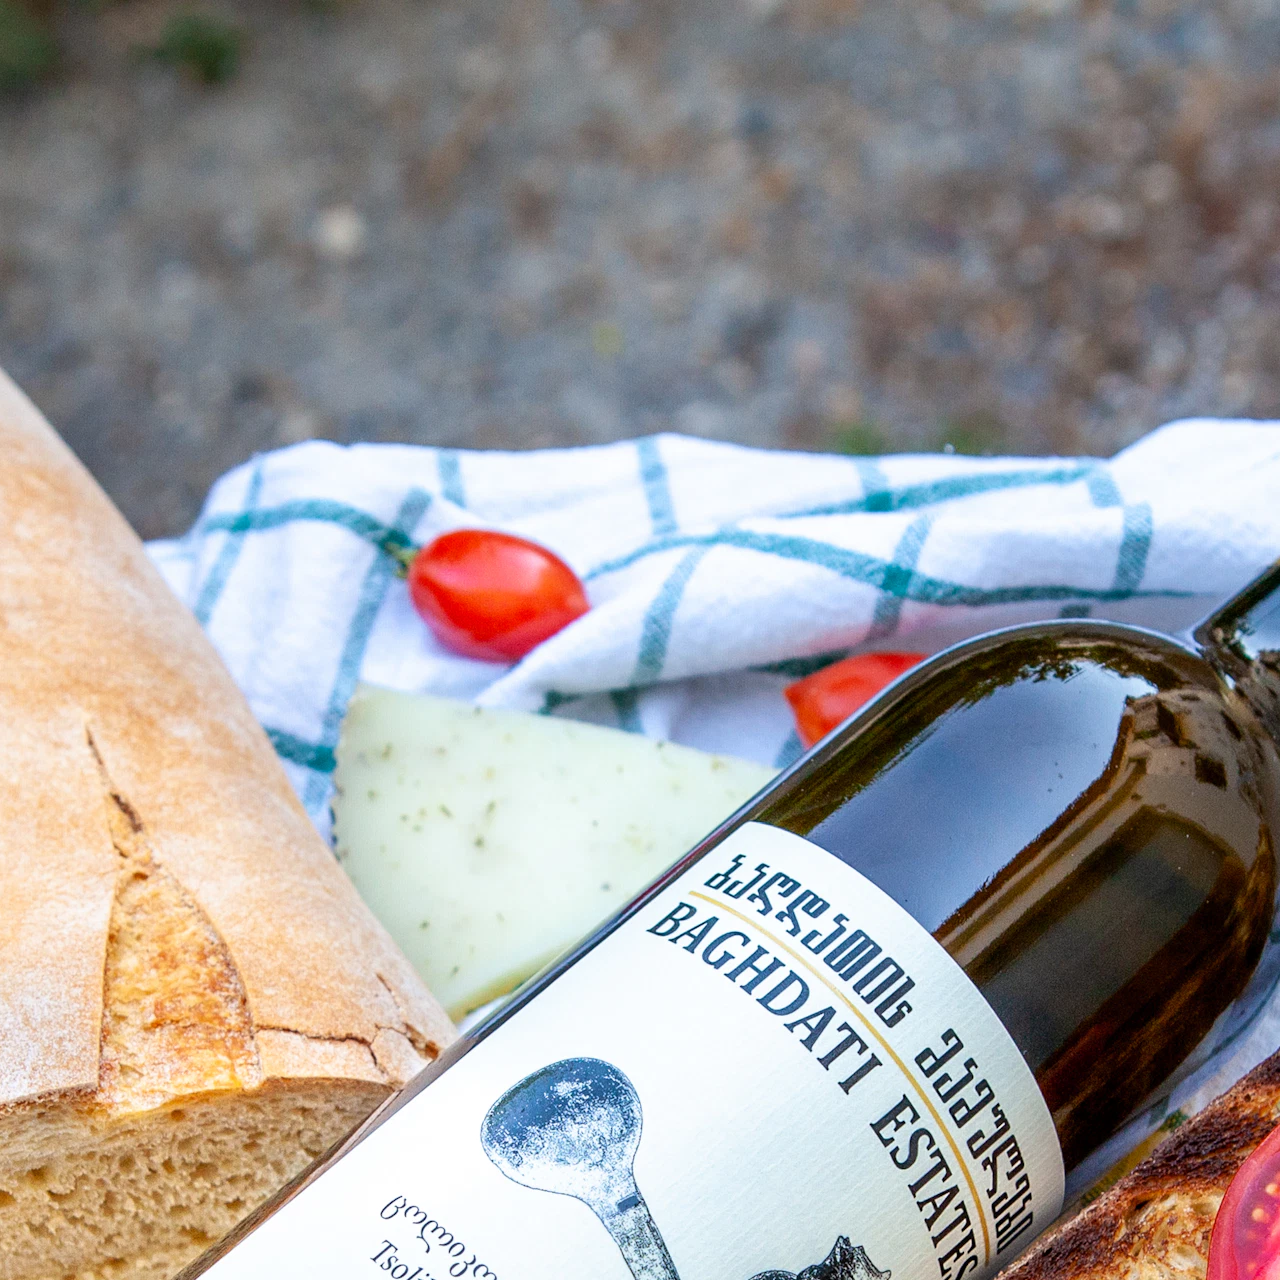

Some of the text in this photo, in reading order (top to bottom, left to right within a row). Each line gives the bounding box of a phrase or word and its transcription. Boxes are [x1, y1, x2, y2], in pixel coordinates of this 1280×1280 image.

[645, 900, 883, 1096] BAGHDATI
[702, 853, 1035, 1256] ბაღდათის მამულები
